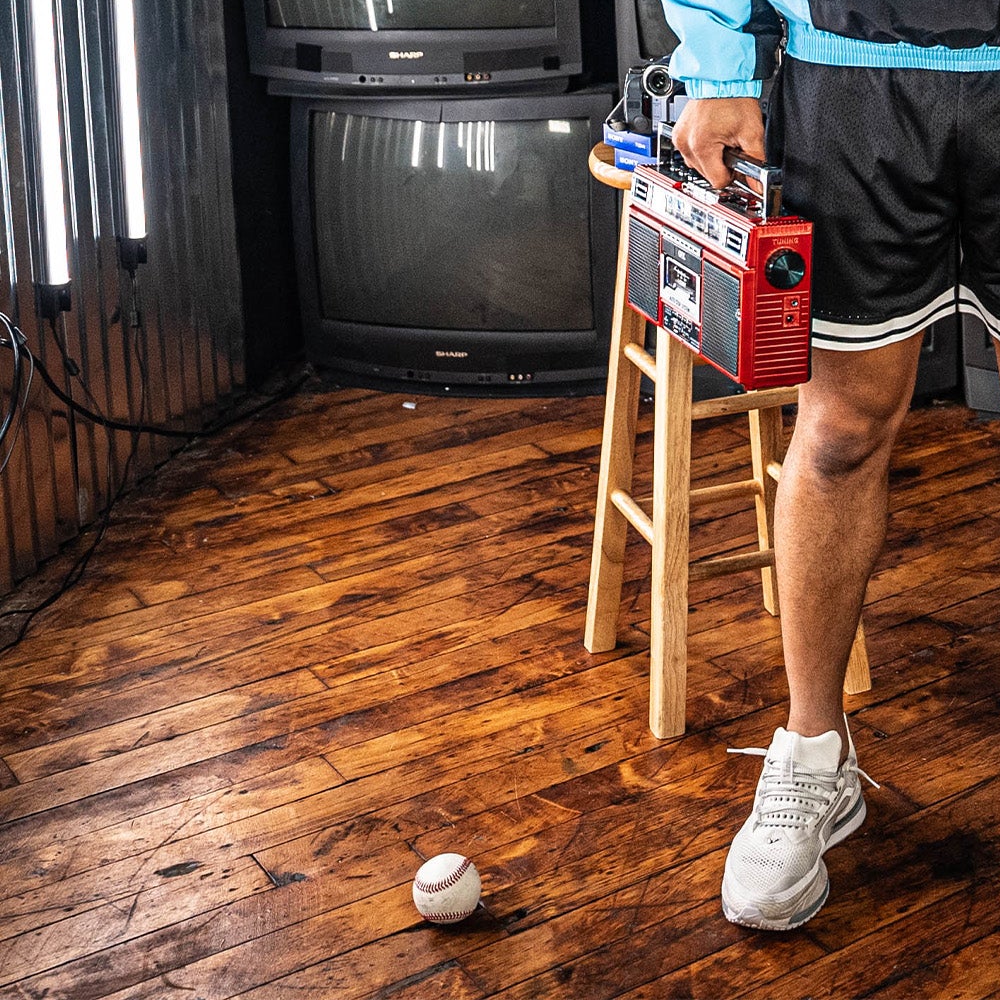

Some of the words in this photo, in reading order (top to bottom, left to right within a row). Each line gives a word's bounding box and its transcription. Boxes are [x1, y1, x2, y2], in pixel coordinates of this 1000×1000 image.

[389, 51, 423, 59] SHARP
[607, 133, 624, 143] SONY
[619, 156, 638, 166] SONY
[772, 237, 799, 245] TUNING
[435, 350, 468, 358] SHARP
